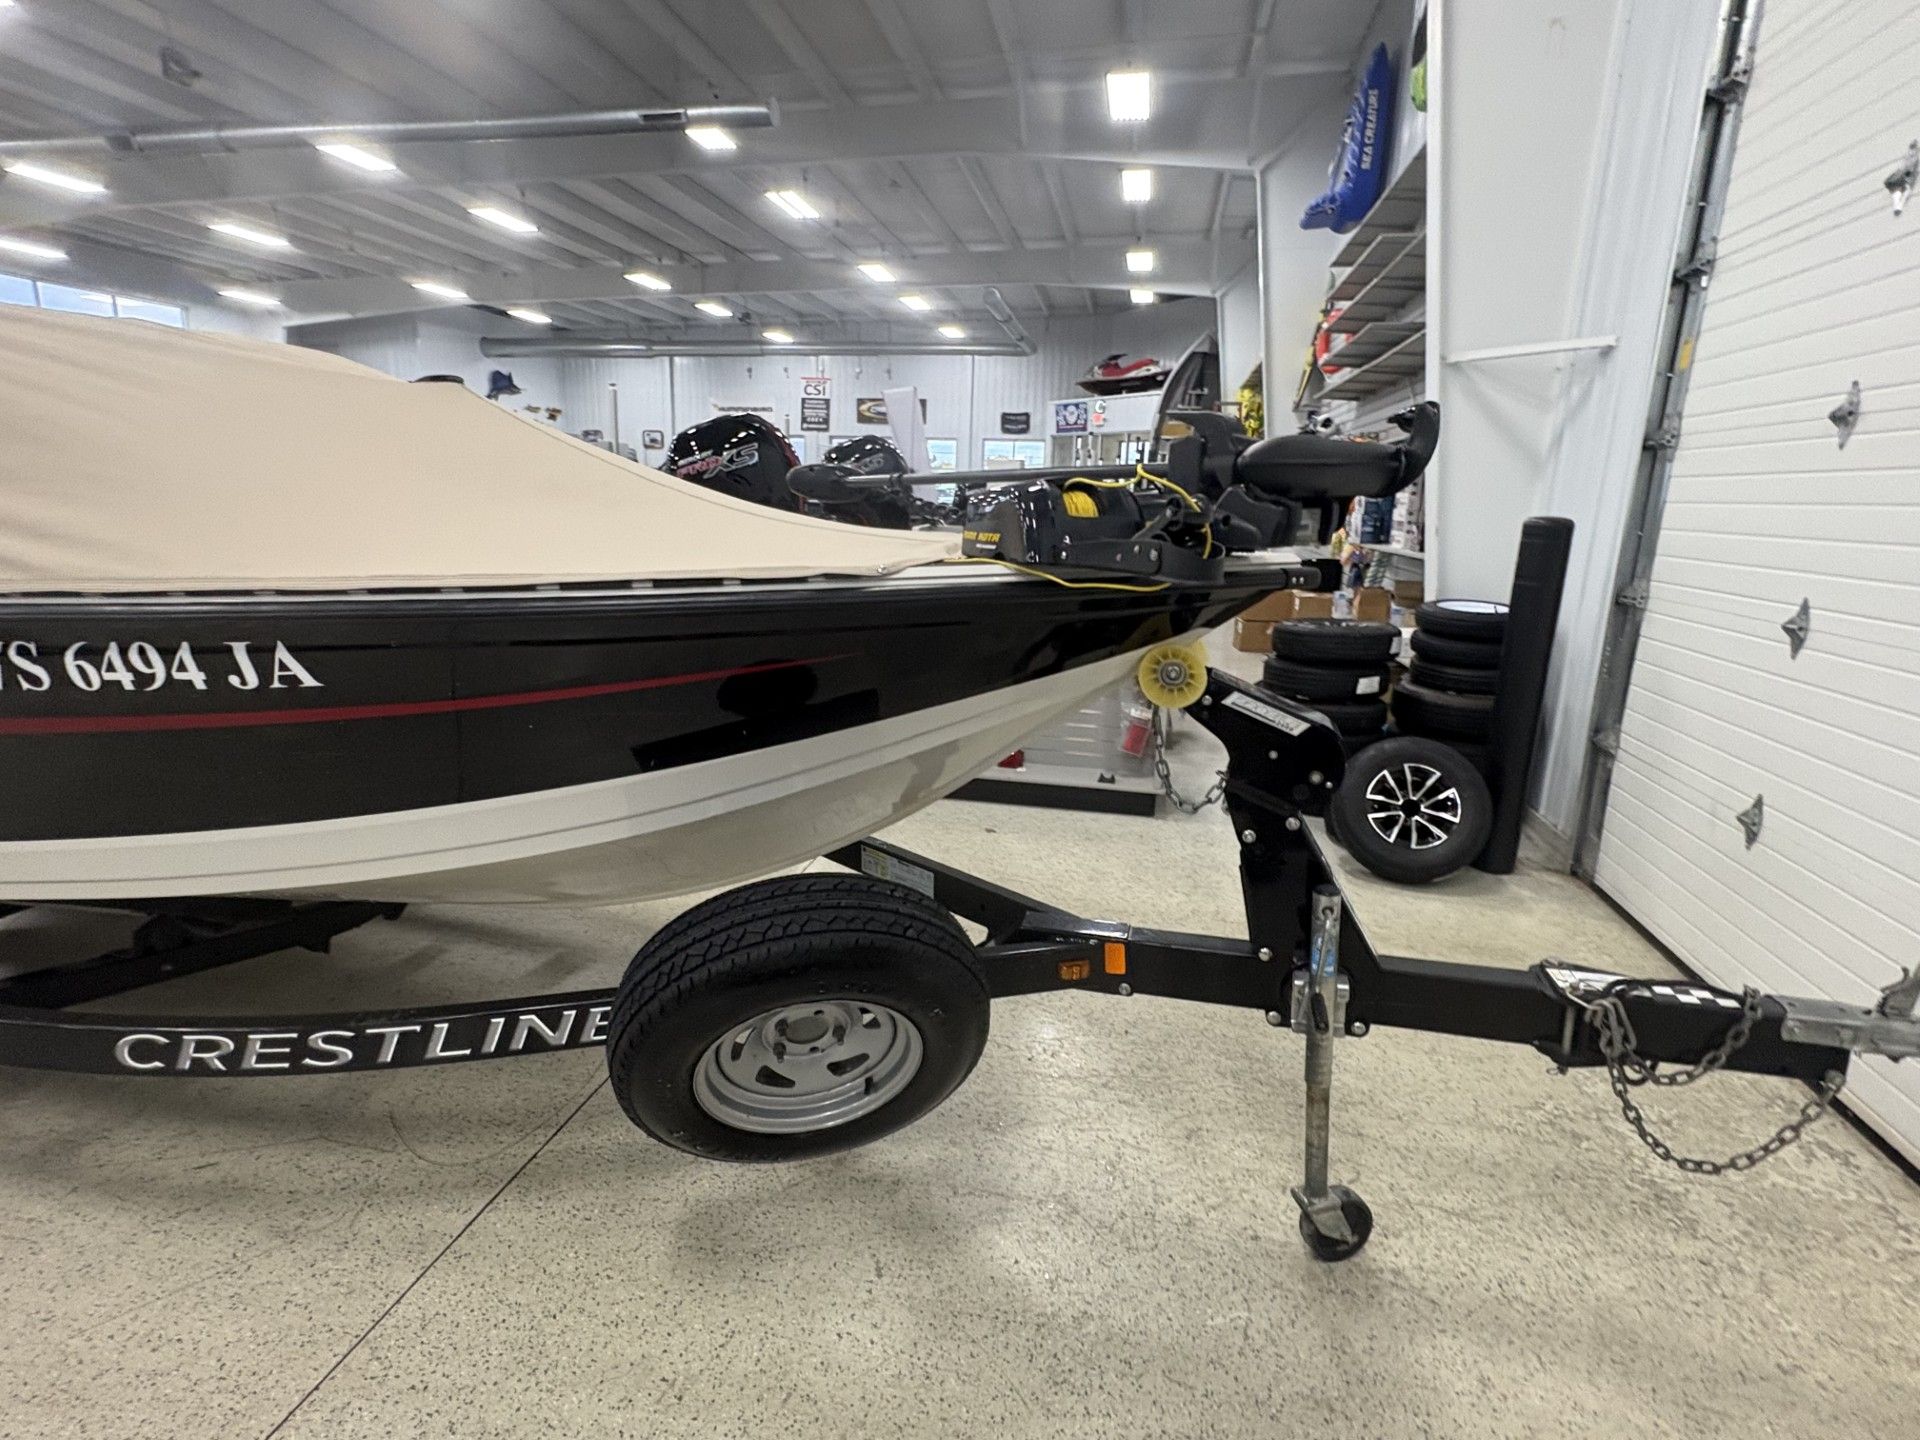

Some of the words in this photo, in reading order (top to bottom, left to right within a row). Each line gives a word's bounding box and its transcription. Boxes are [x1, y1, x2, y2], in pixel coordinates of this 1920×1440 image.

[1361, 146, 1373, 170] SEA
[0, 640, 51, 691] S
[63, 641, 208, 692] 6494
[223, 640, 326, 690] JA
